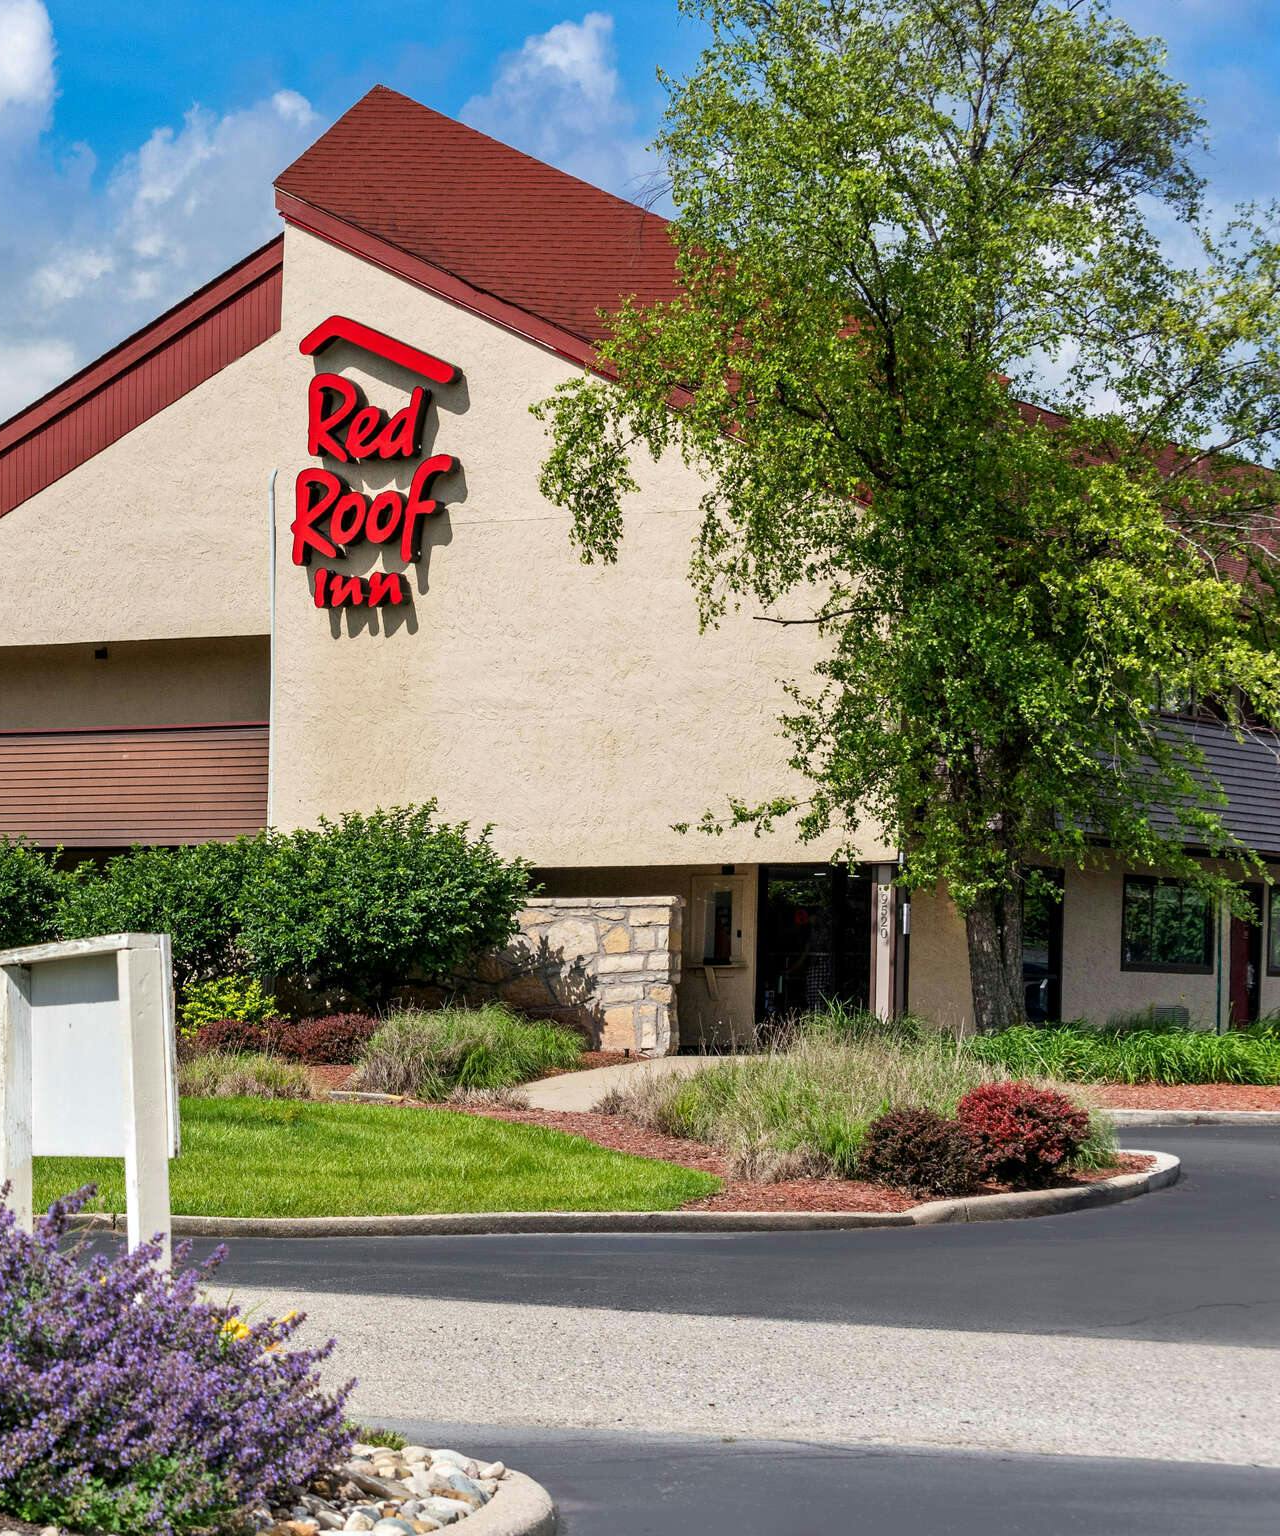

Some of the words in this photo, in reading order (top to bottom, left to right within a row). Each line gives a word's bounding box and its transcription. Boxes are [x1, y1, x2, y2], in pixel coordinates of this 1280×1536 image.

[307, 372, 429, 464] Red
[291, 454, 457, 566] Roof
[880, 893, 888, 939] 9520
